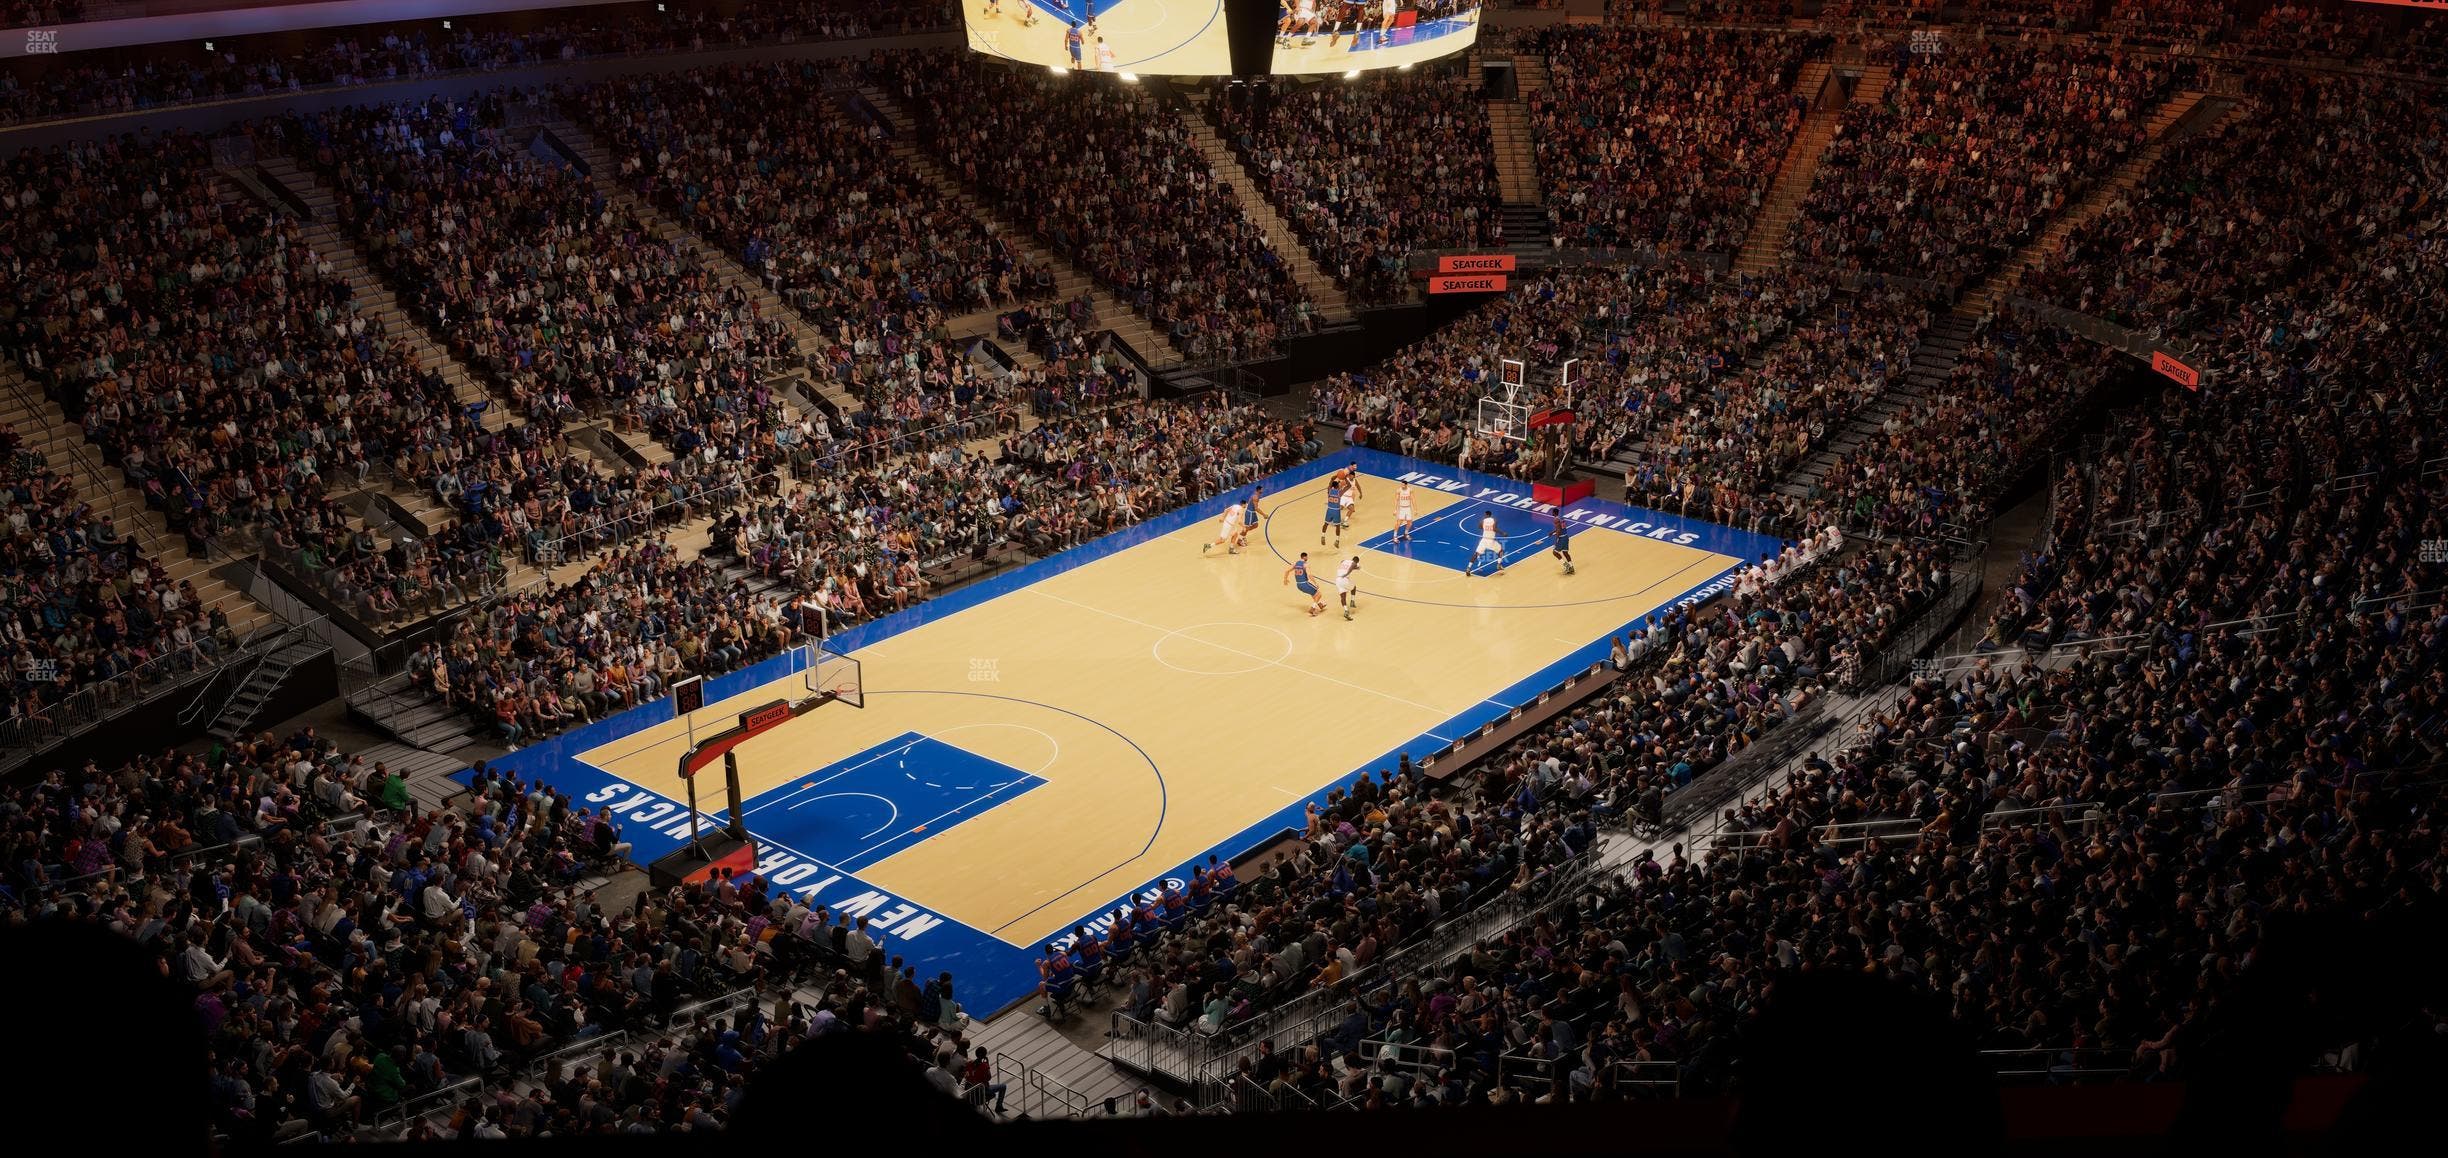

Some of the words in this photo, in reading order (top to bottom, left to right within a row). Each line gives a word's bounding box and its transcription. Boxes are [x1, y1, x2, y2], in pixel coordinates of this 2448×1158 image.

[1443, 280, 1493, 290] SEATGEEK
[1453, 259, 1503, 270] SEATGEEK
[1395, 471, 1470, 492] NEW
[1562, 508, 1700, 544] KNICKS
[751, 707, 785, 727] SEATGEEK
[585, 783, 717, 841] NICKS
[751, 841, 843, 897] YOR
[830, 890, 945, 941] NEW
